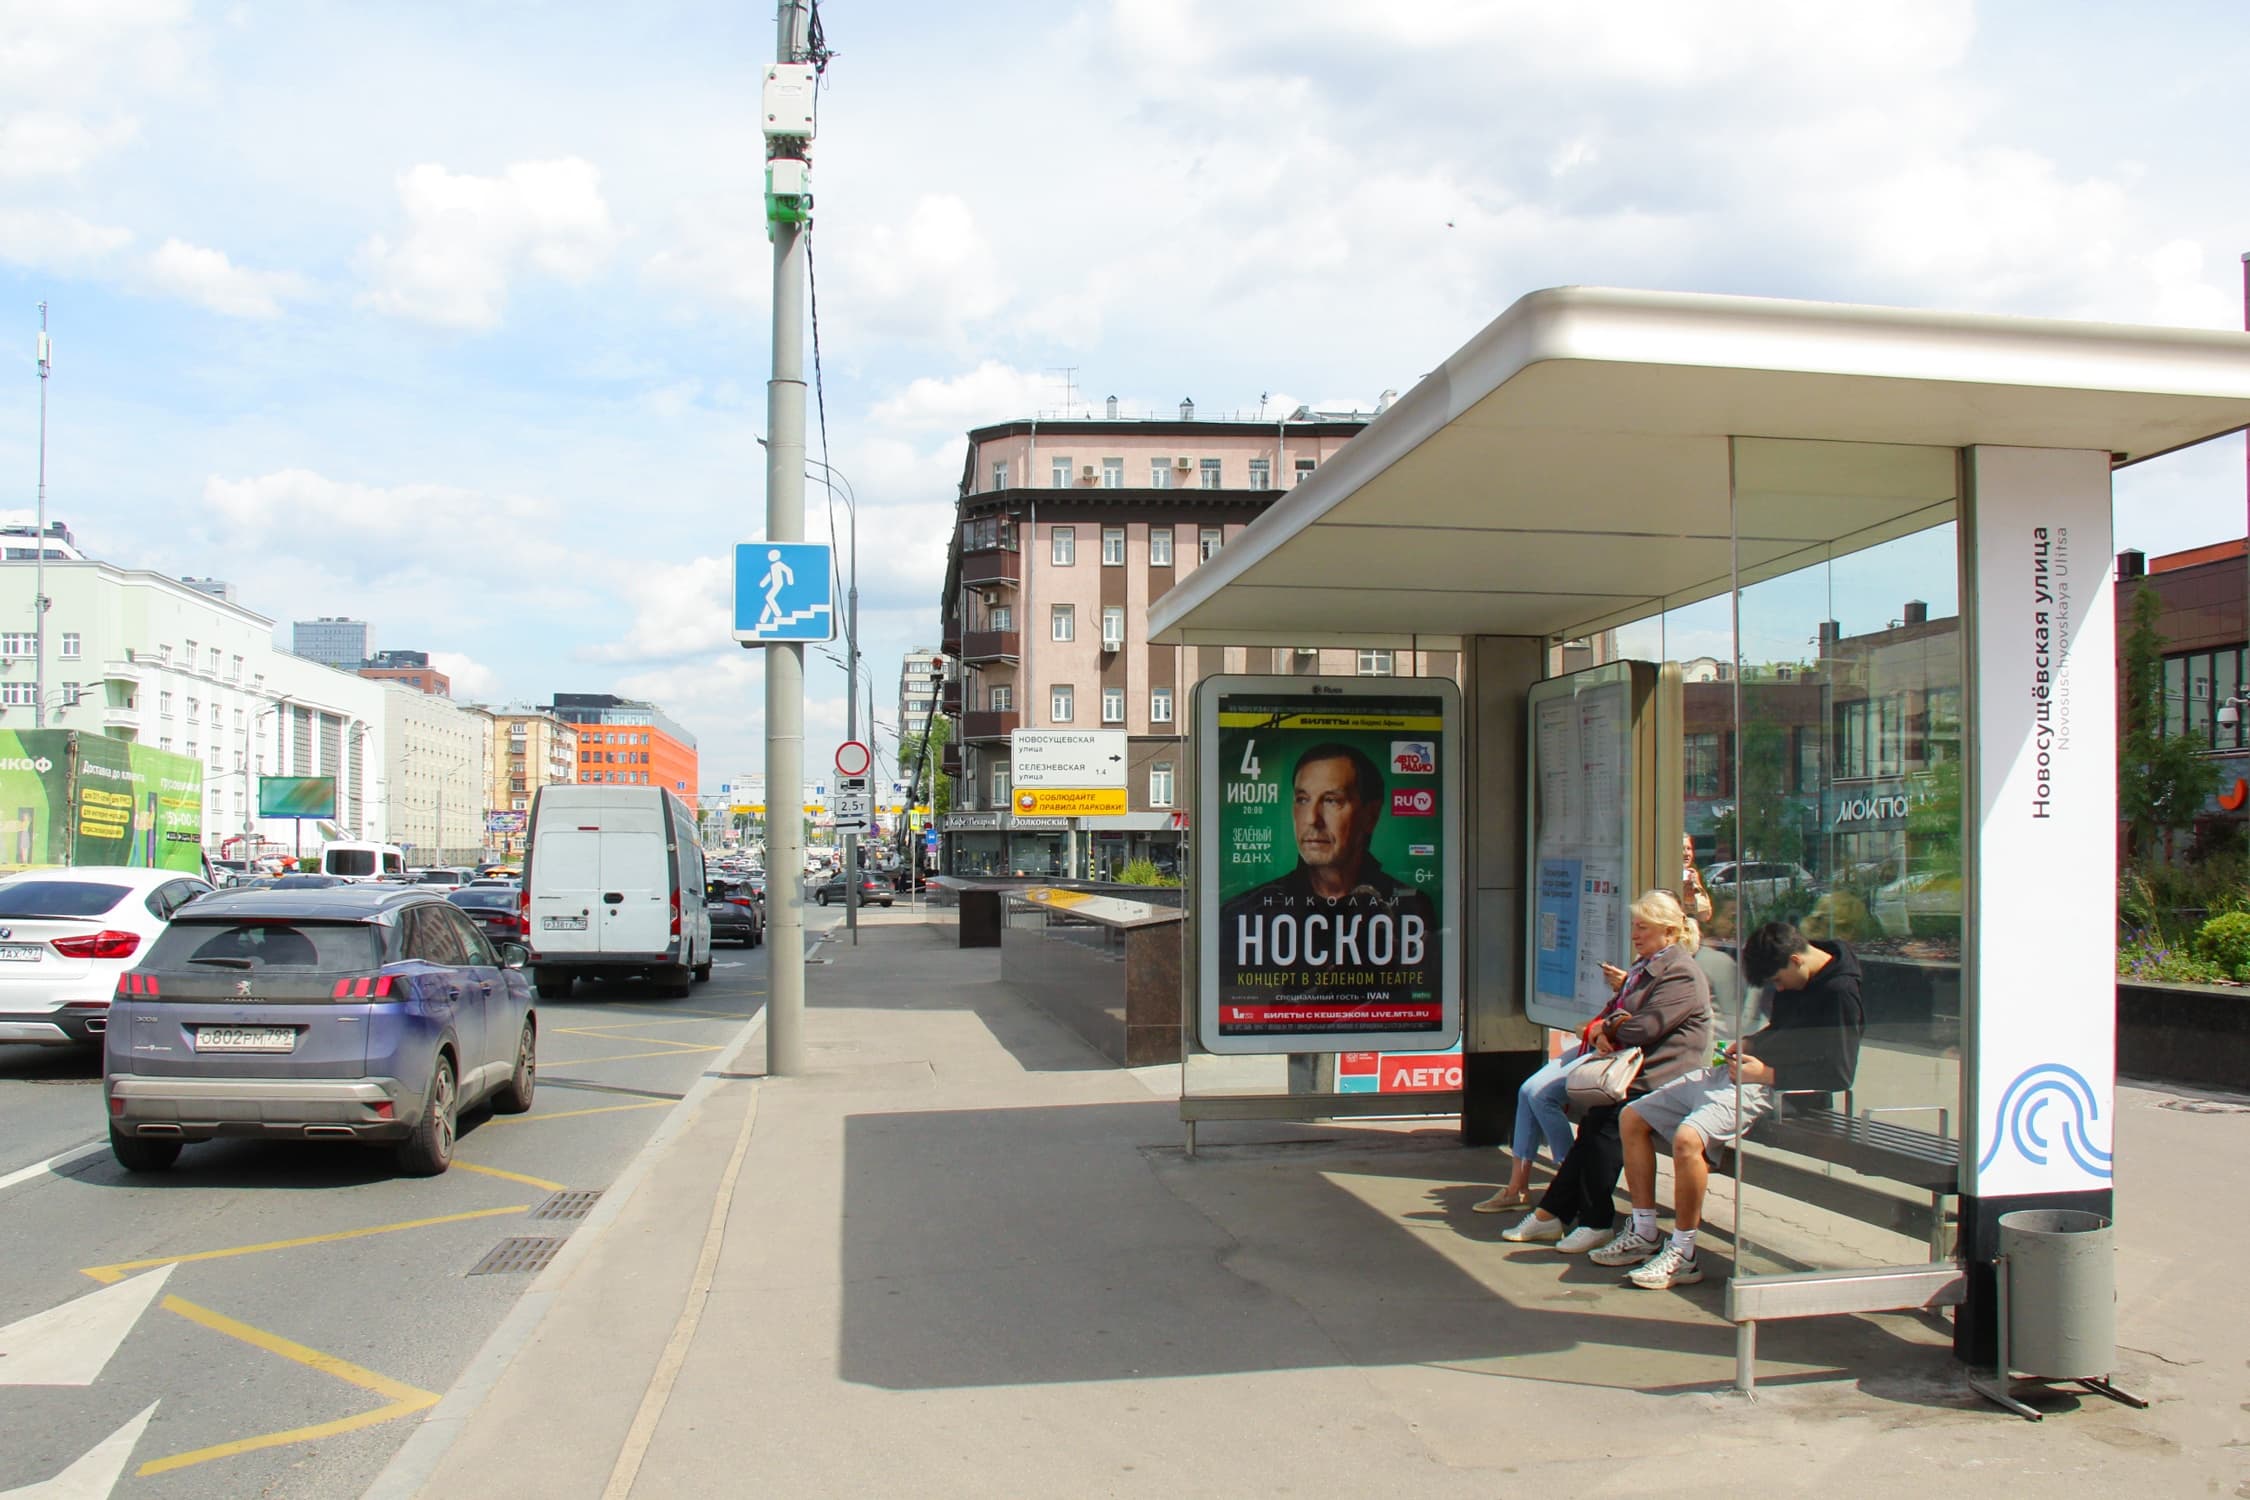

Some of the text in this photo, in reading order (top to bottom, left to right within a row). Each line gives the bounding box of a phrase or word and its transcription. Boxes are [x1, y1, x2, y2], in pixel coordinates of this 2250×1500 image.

[2054, 527, 2070, 750] Novosuschyovskaya Ulitsa
[2032, 527, 2054, 818] Новосущёвская улица
[1300, 717, 1349, 725] БИЛЕТЫ
[1018, 736, 1095, 745] НОВОСУЩЕВСКАЯ
[1240, 739, 1261, 780] 4
[1394, 755, 1419, 764] АВТО
[1018, 763, 1085, 771] СЕЛЕЗНЕВСКАЯ
[1400, 763, 1433, 772] РАДИО
[1039, 793, 1096, 802] СОБЛЮДАЙТЕ
[1227, 783, 1278, 804] ИЮЛЯ
[1394, 796, 1413, 807] RU
[1232, 853, 1272, 863] ВДНХ
[1415, 869, 1434, 883] 6+
[1238, 914, 1425, 966] НОСКОВ
[1237, 971, 1423, 987] КОНЦЕРТ В ЗЕЛЕНОМ ТЕАТРЕ
[1366, 992, 1390, 1000] IVAN
[1371, 1010, 1429, 1018] LIVE.MTS.RU
[1392, 1067, 1462, 1088] ЛЕТО
